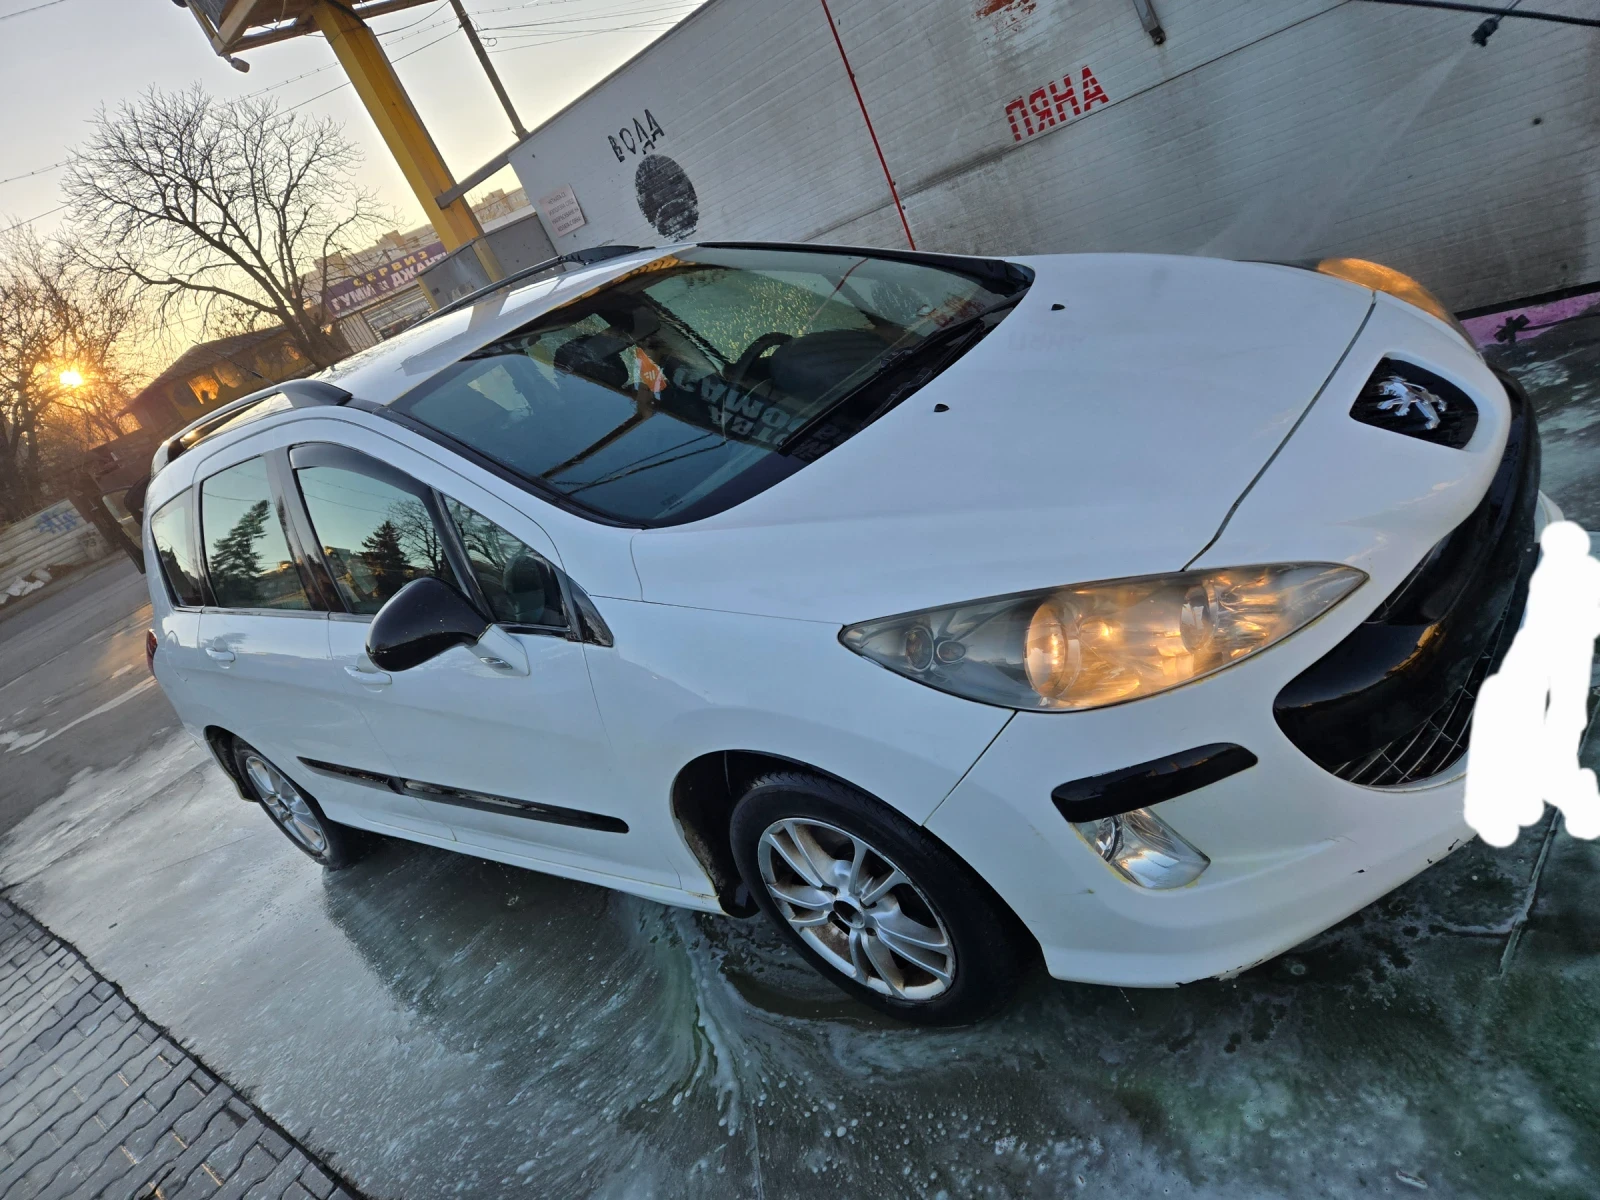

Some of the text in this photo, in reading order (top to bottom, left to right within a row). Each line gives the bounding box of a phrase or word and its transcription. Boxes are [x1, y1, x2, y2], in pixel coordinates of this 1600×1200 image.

[1004, 65, 1110, 142] ПЯНА
[607, 108, 665, 163] ВОДА
[353, 251, 428, 287] СЕРВИЗ
[331, 283, 377, 311] ГУМИ
